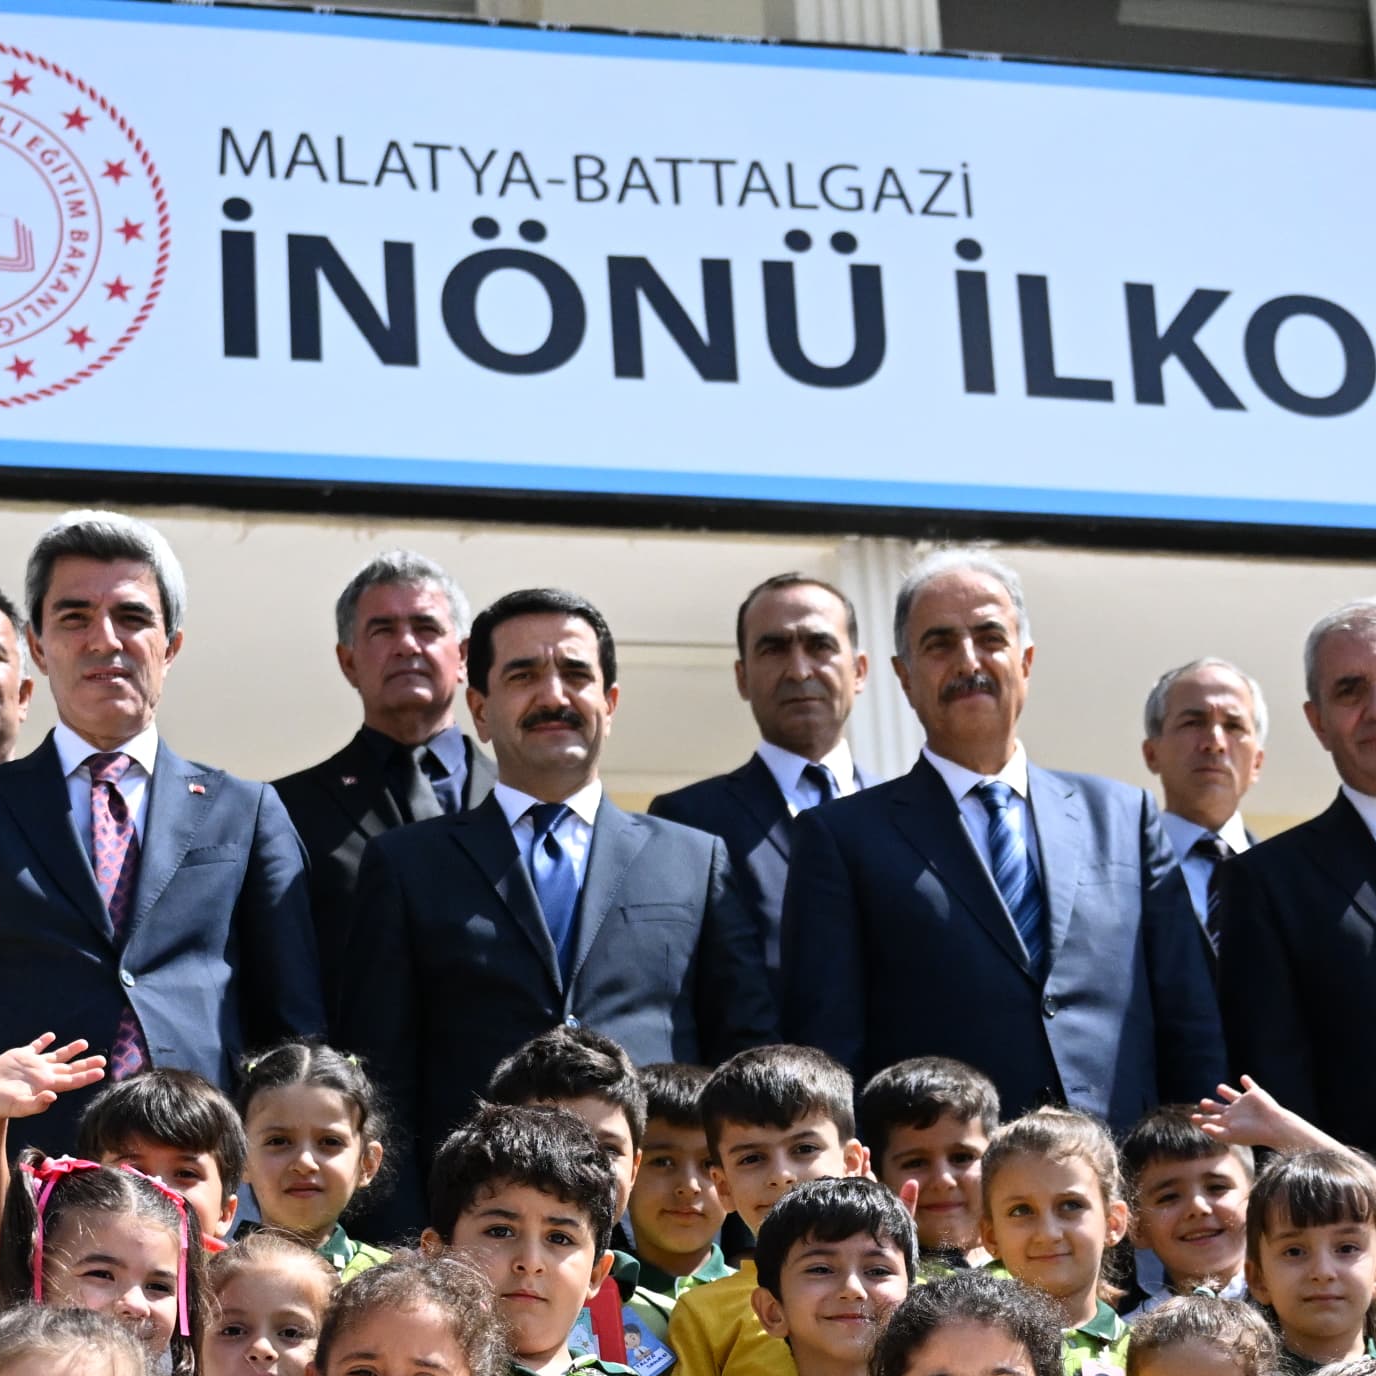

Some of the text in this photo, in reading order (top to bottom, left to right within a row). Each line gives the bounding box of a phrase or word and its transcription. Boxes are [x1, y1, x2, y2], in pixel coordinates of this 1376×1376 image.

[23, 134, 88, 219] EĞİTİM
[219, 126, 975, 219] MALATYA-BATTALGAZİ
[220, 196, 888, 390] İNÖNÜ
